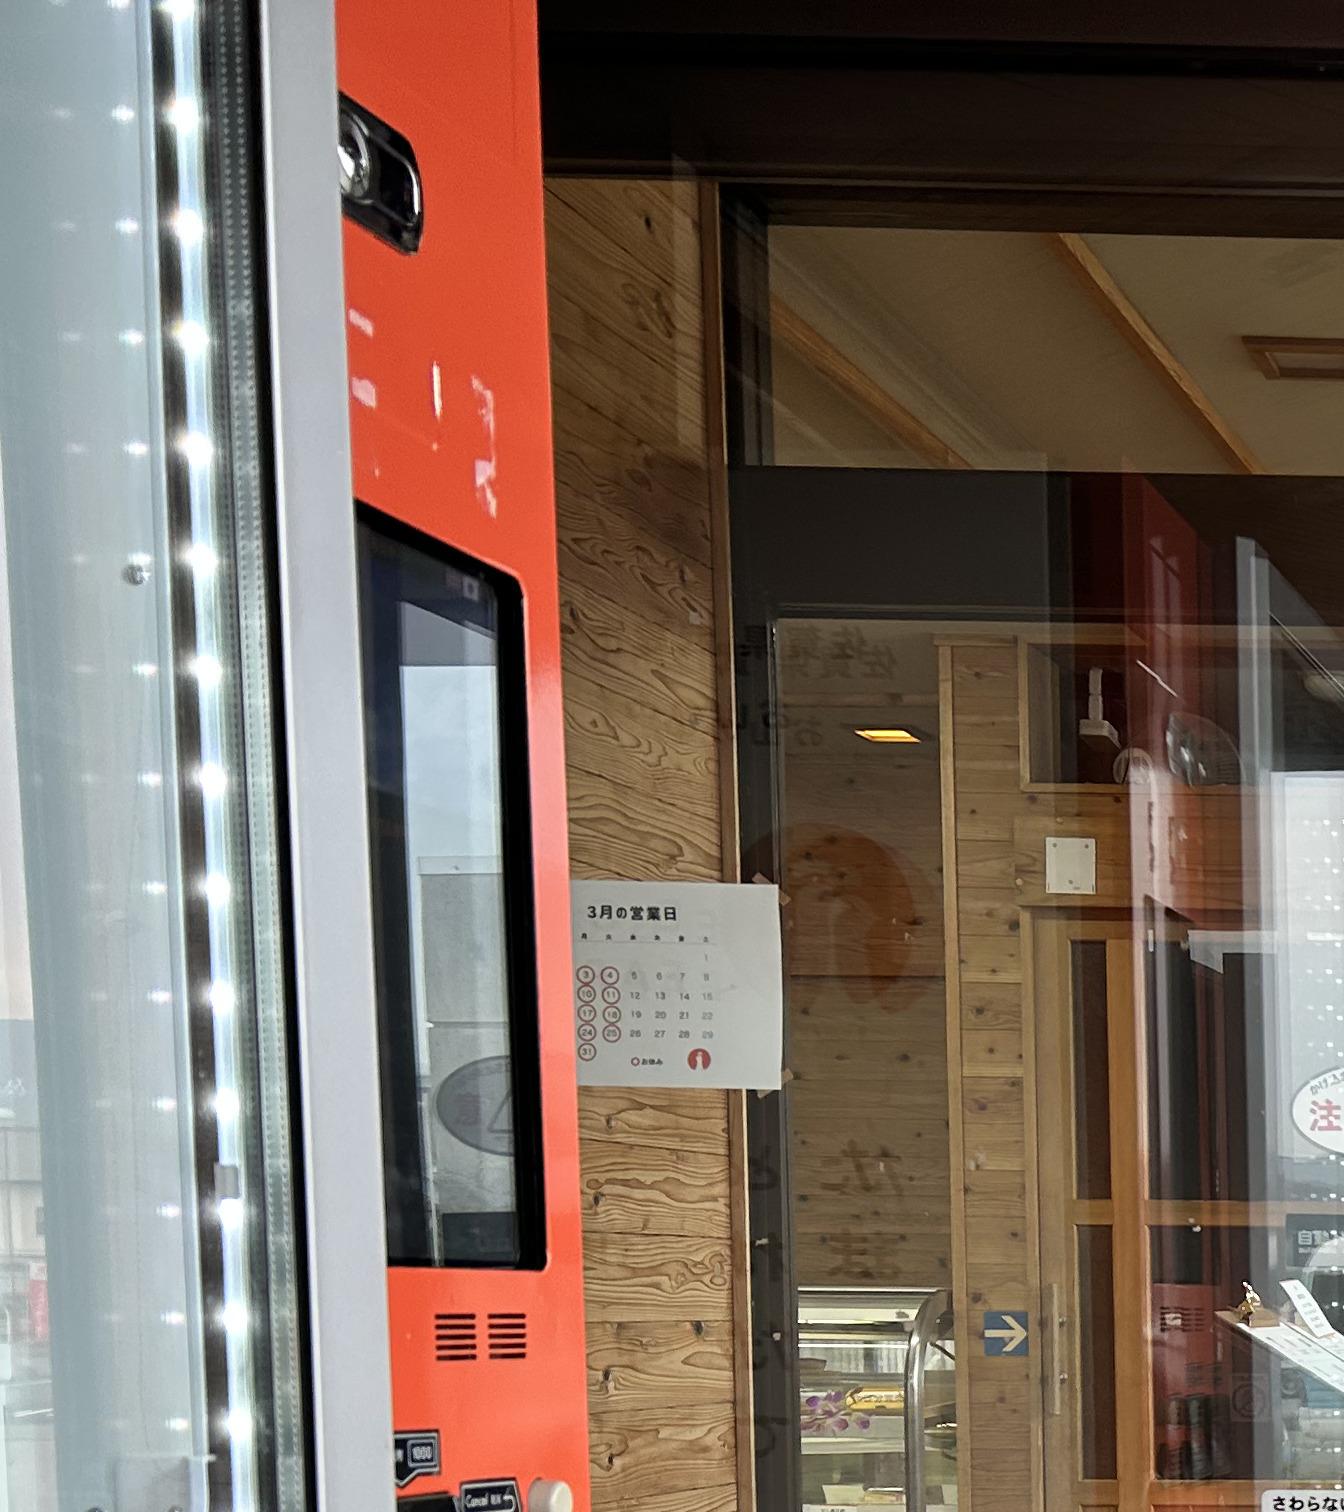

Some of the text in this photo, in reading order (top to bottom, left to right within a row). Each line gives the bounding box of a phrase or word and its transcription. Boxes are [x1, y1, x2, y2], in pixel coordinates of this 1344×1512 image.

[587, 905, 677, 921] 3月の営業日
[582, 971, 589, 979] 3
[607, 971, 613, 979] 4
[656, 972, 663, 981] 6
[679, 973, 686, 981] 7
[581, 990, 592, 998] 10
[606, 991, 616, 999] 11
[630, 991, 641, 1000] 12
[655, 992, 666, 1000] 13
[679, 992, 690, 1001] 14
[582, 1009, 713, 1020] 17 18 19 20 21 22
[582, 1028, 714, 1039] 24 25 26 27 28 29
[581, 1048, 592, 1056] 31
